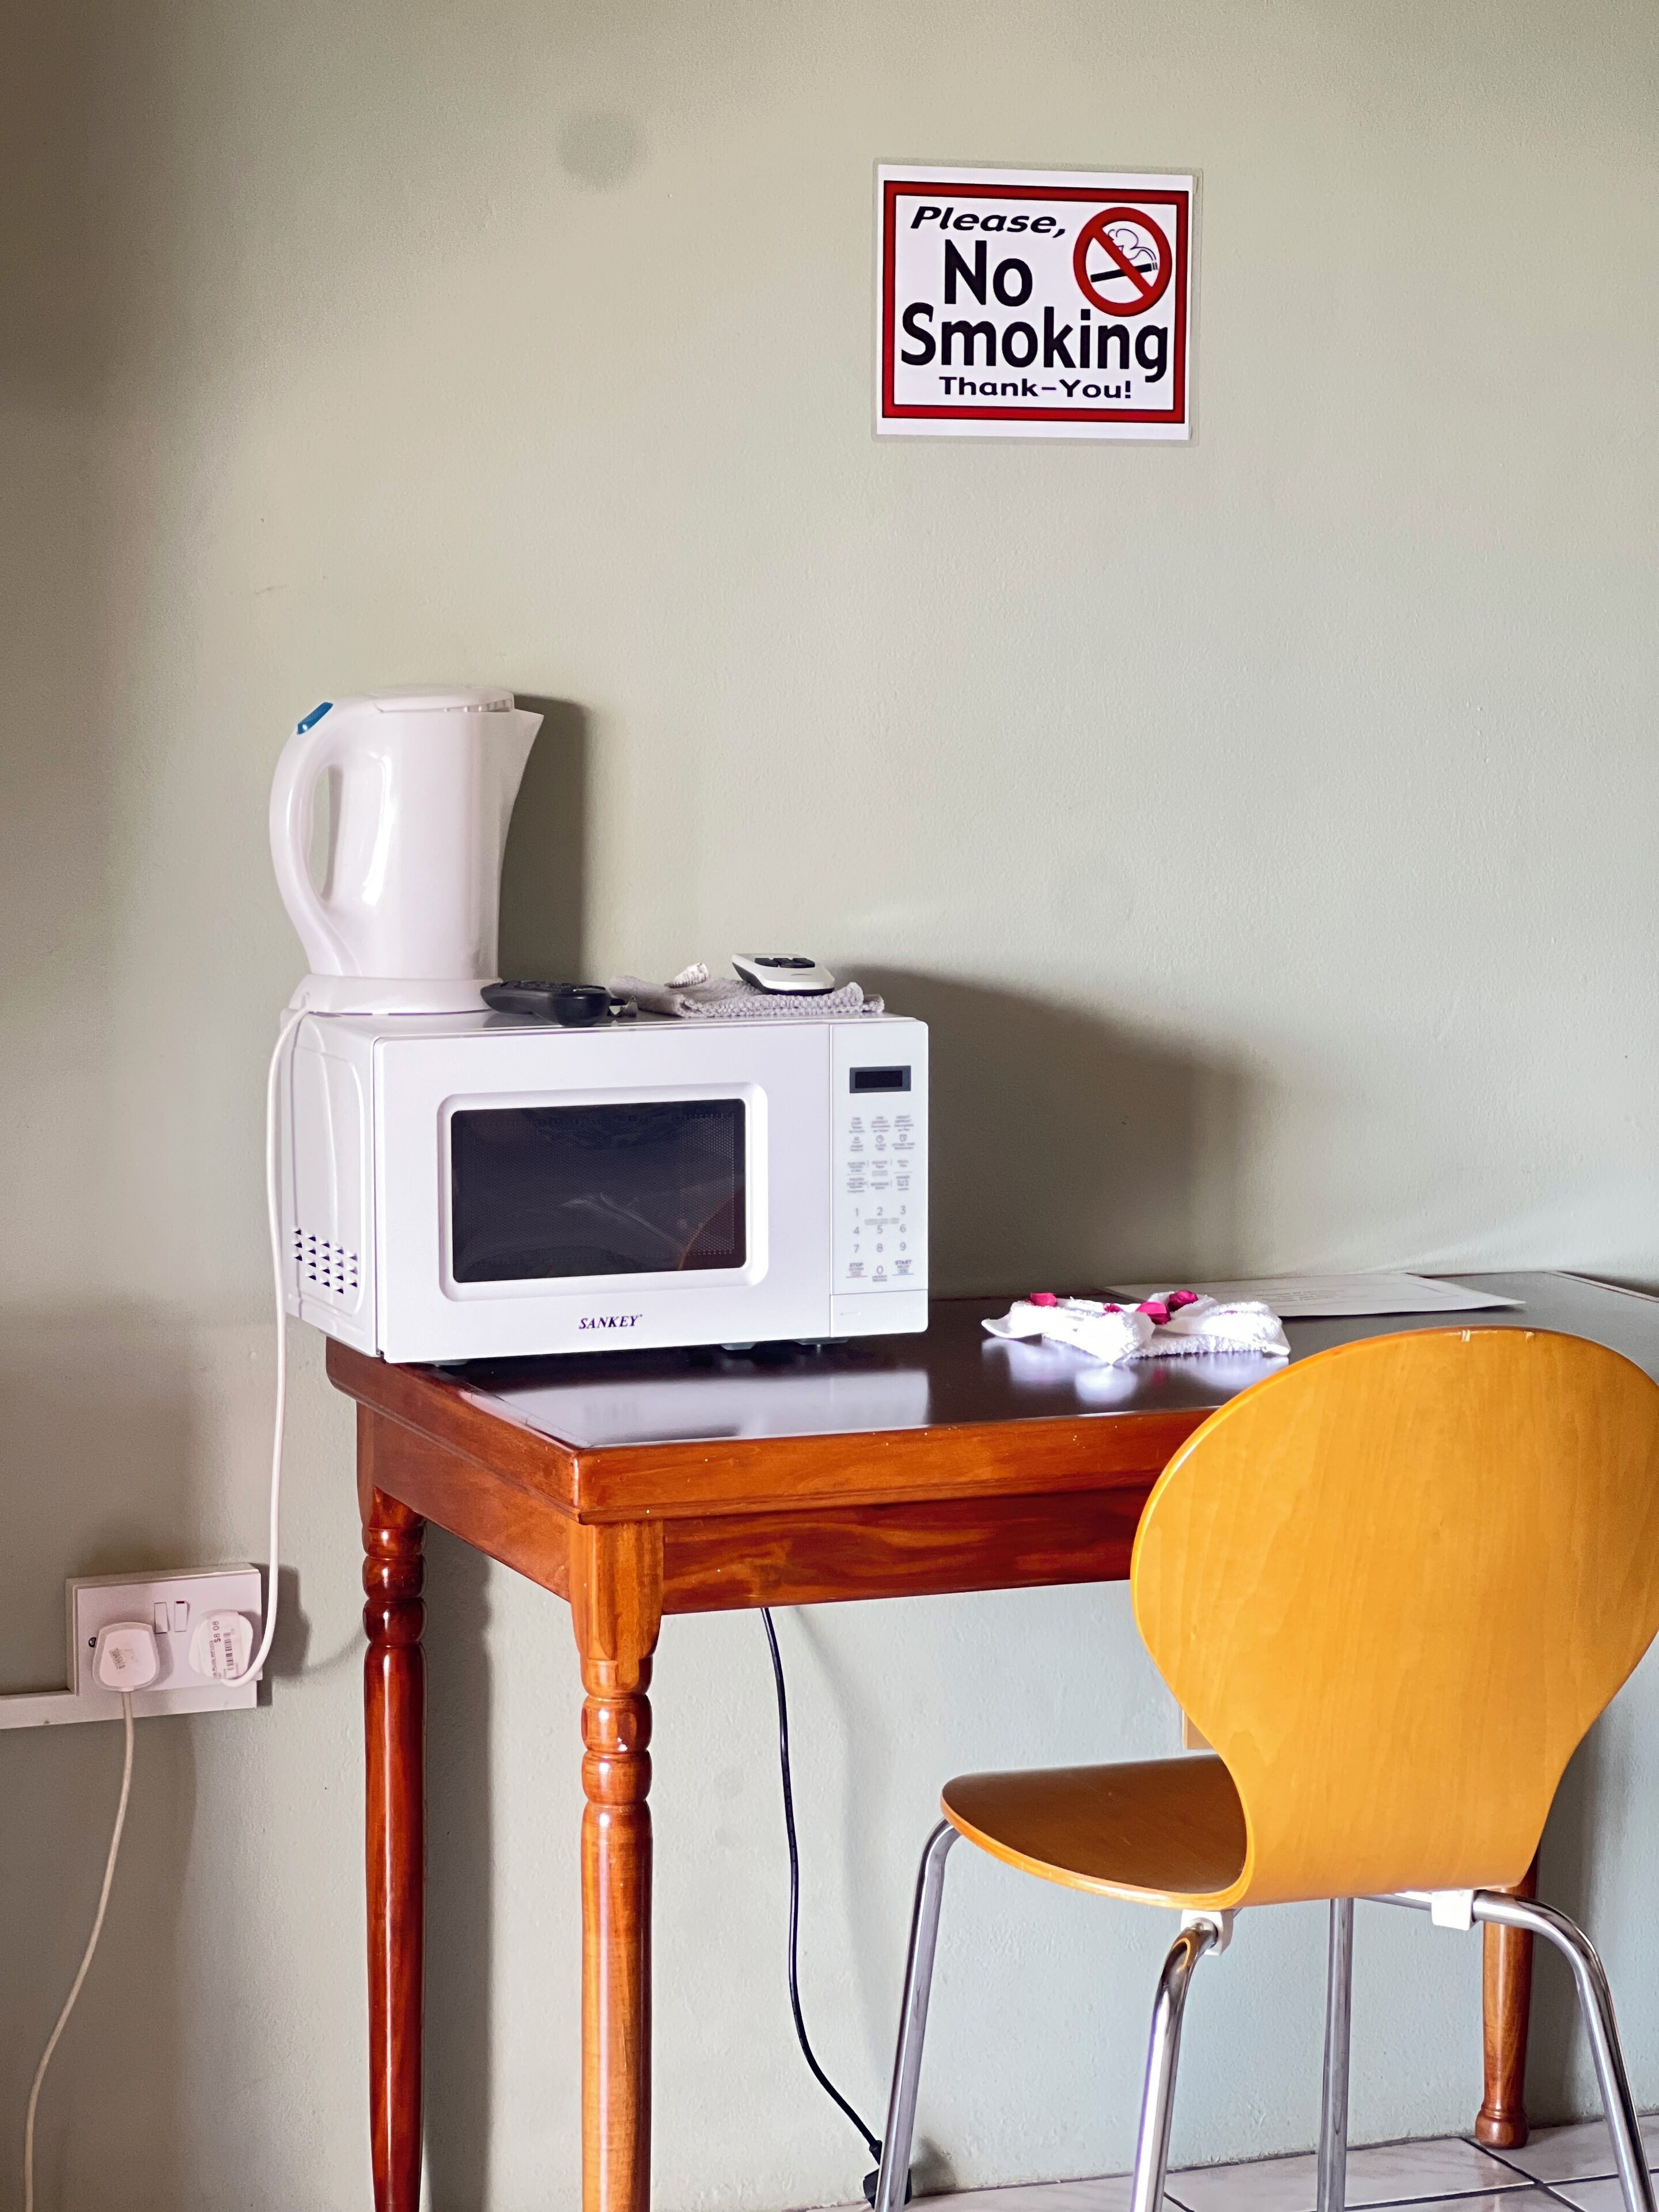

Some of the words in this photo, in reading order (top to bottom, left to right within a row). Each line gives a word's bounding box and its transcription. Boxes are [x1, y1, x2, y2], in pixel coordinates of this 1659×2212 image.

[910, 206, 1066, 238] Please,
[944, 239, 1033, 307] No
[901, 301, 1168, 383] Smoking
[939, 376, 1131, 399] Thank-You!
[855, 1208, 859, 1217] 1
[877, 1207, 883, 1215] 2
[900, 1206, 906, 1214] 3
[853, 1226, 859, 1234] 4
[877, 1225, 883, 1234] 5
[900, 1224, 906, 1233] 6
[854, 1244, 859, 1253] 7
[877, 1243, 883, 1252] 8
[900, 1242, 906, 1251] 9
[876, 1265, 884, 1274] 0
[578, 1315, 639, 1329] SANKEY
